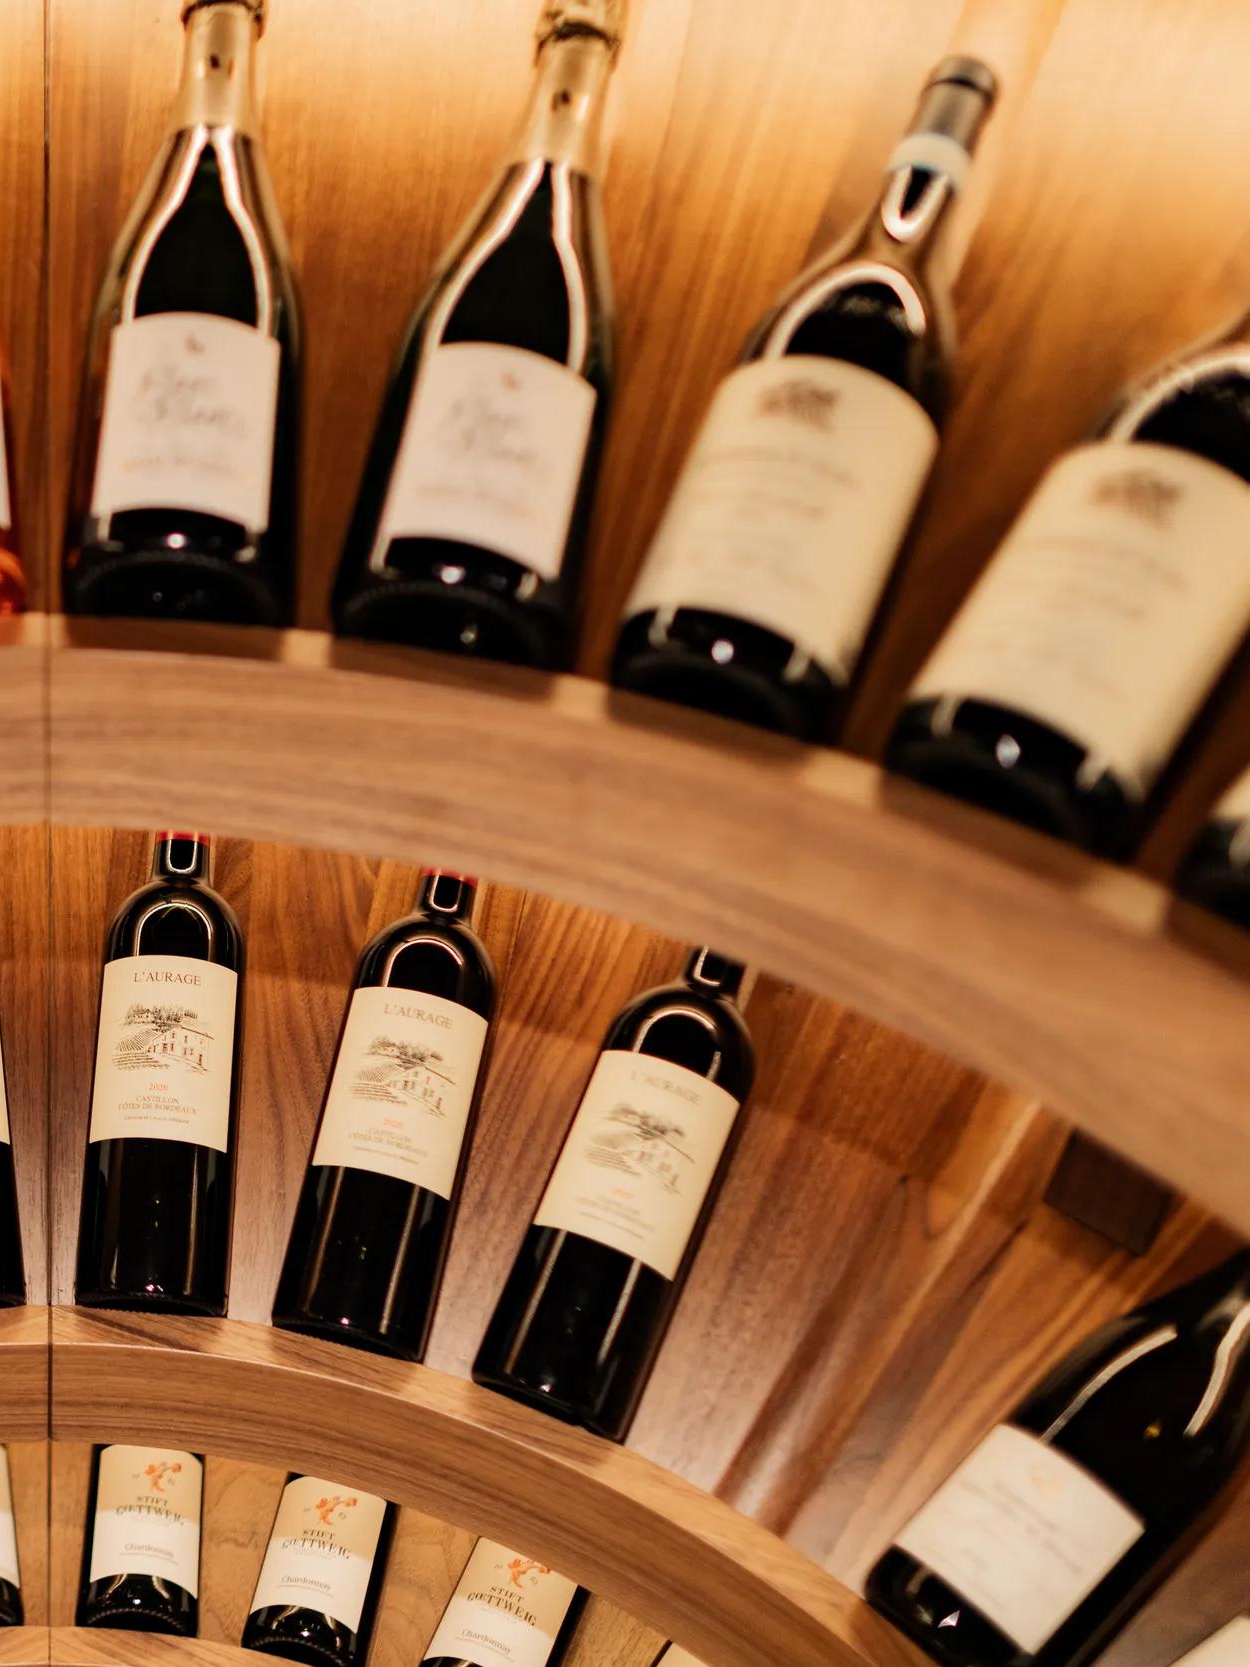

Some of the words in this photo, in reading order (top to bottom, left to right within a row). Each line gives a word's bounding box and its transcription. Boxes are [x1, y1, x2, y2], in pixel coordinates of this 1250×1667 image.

[134, 971, 201, 985] L'AURAGE
[383, 1003, 454, 1029] L'AURAGE
[489, 1585, 526, 1603] STIFT
